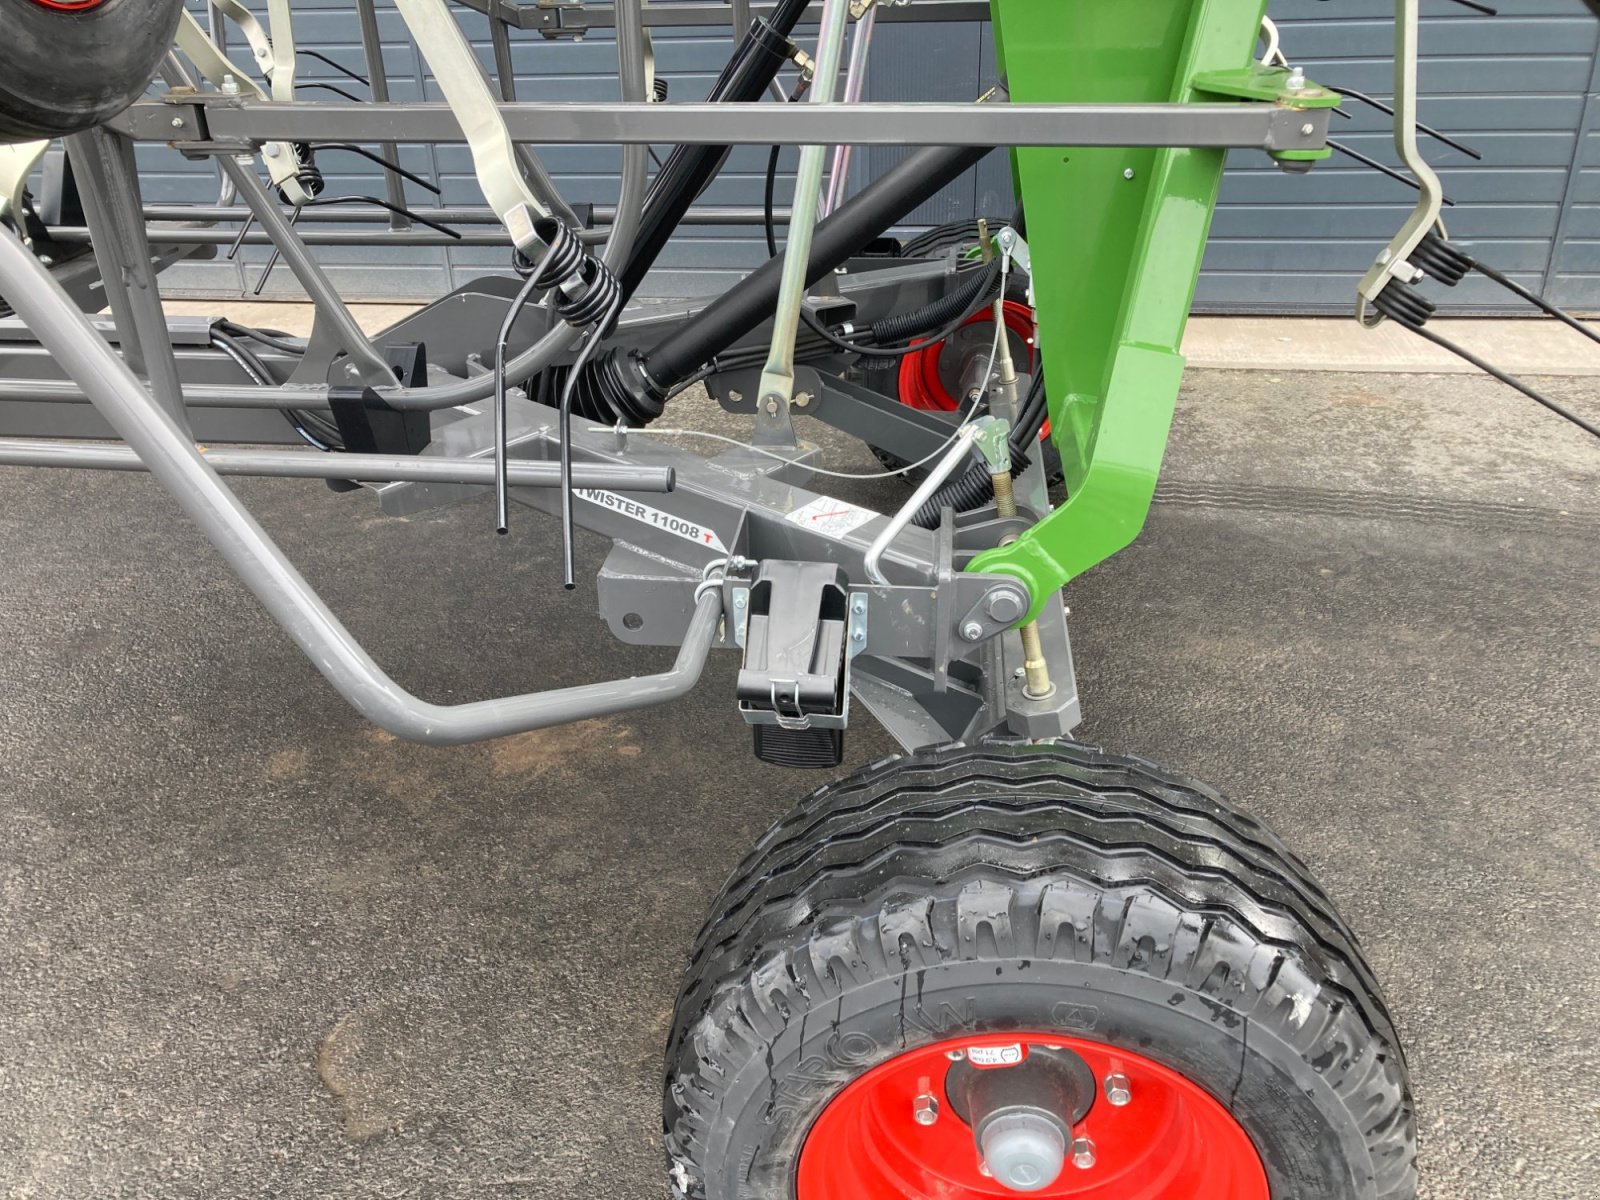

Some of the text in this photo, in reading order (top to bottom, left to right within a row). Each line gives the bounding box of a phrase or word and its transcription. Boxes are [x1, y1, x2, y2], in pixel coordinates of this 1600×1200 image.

[578, 488, 713, 544] TWISTER 11008 T
